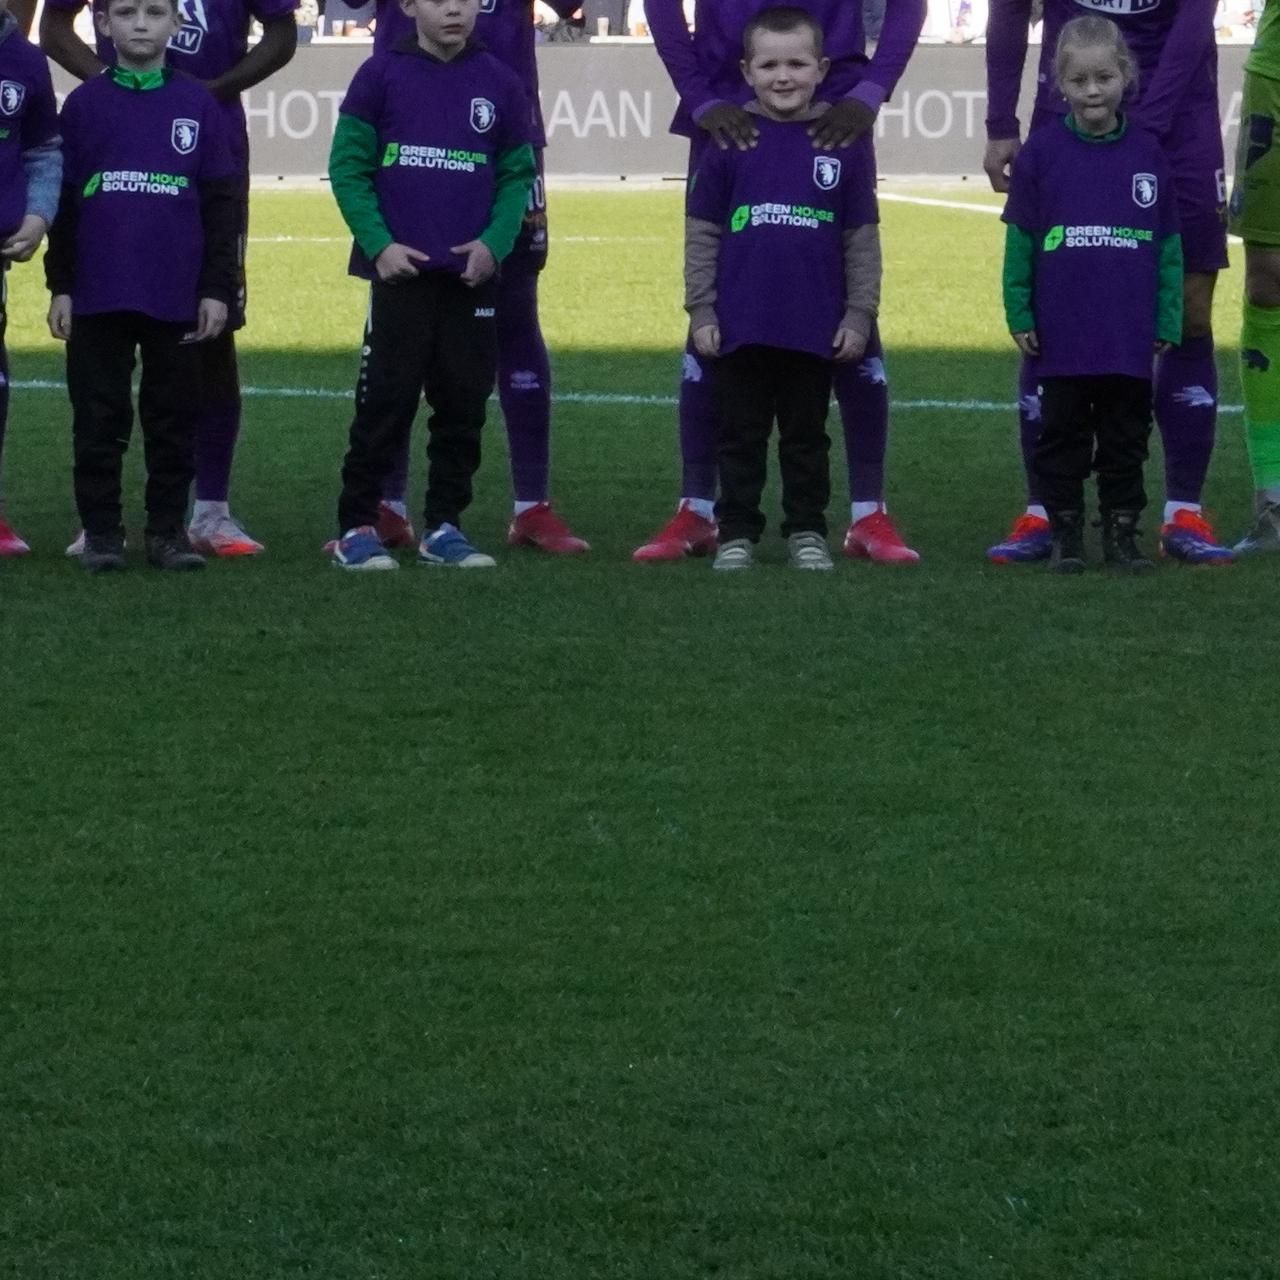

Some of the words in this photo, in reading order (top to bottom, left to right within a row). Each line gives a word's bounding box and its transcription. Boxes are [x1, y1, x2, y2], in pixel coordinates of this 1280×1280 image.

[242, 90, 347, 139] HOT
[545, 90, 651, 139] AAN
[877, 90, 988, 139] HOT
[399, 145, 446, 158] GREEN
[399, 156, 475, 172] SOLUTIONS
[102, 171, 148, 181] GREEN
[150, 173, 189, 187] HOUS
[102, 181, 179, 195] SOLUTIONS
[751, 203, 792, 216] GREEN
[1066, 225, 1111, 236] GREEN
[1112, 227, 1153, 241] HOUSE
[1065, 236, 1138, 249] SOLUTIONS
